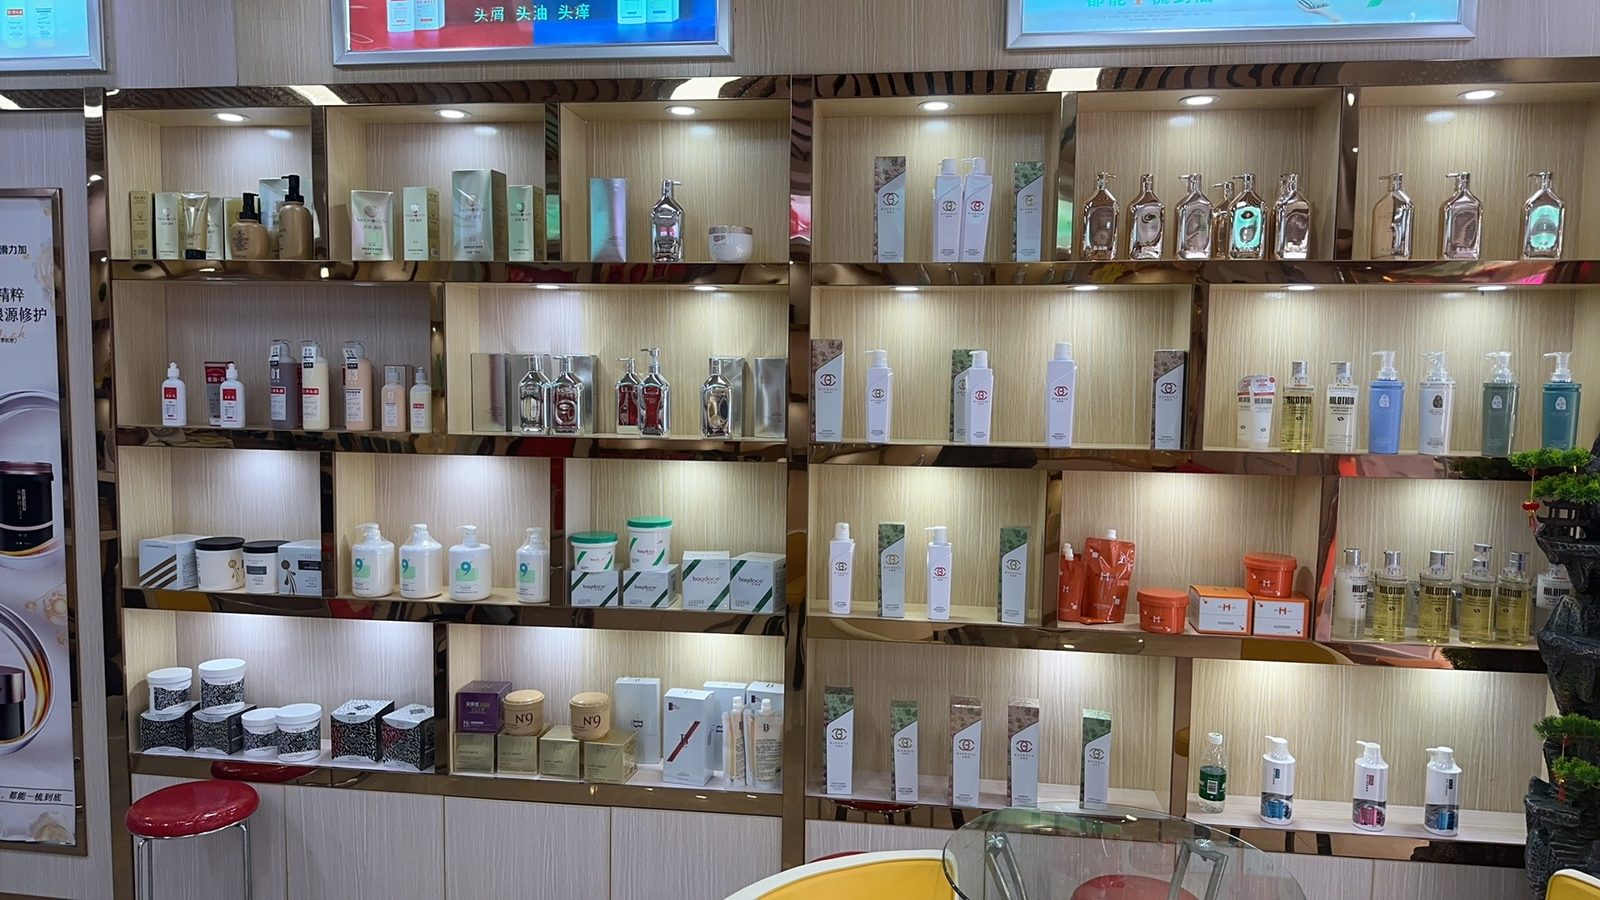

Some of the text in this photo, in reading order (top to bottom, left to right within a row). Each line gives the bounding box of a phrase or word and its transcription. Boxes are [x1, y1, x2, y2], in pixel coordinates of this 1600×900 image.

[474, 3, 590, 22] 头屑 头油 头痒
[1329, 396, 1354, 405] HILOTION
